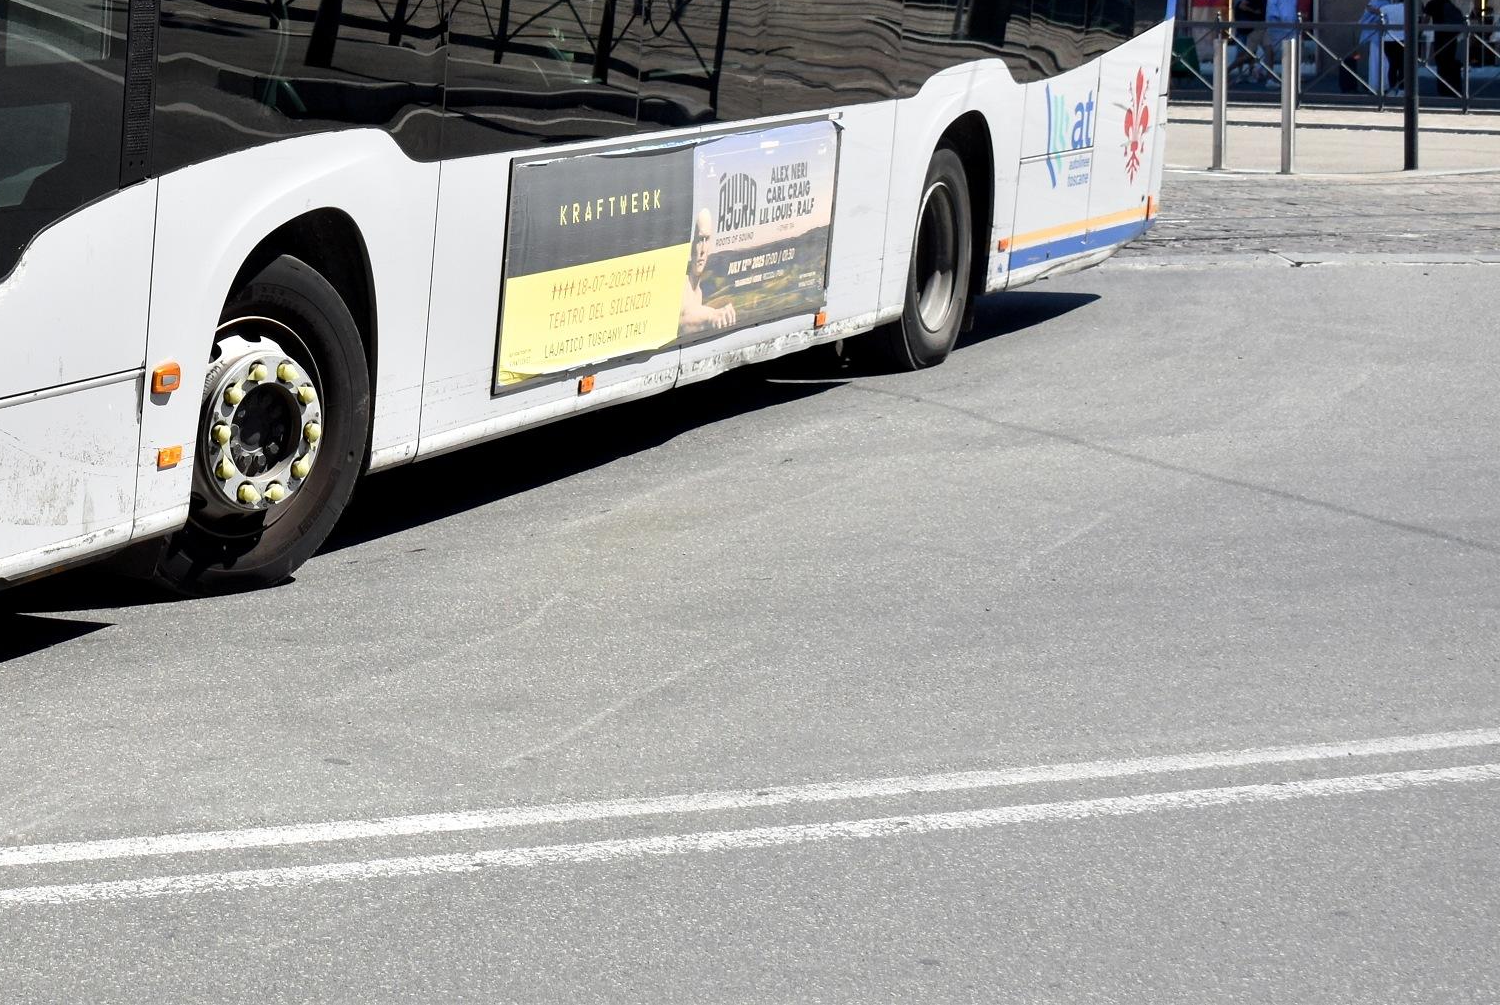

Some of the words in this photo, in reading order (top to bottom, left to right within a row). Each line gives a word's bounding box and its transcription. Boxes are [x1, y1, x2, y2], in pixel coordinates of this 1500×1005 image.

[1071, 90, 1094, 148] at
[771, 165, 790, 184] ALEX
[791, 161, 808, 180] NERI
[766, 185, 786, 204] CARL
[788, 180, 811, 200] CRAIG
[559, 189, 662, 226] KRAFTWERK
[771, 203, 793, 223] LOUIS
[796, 198, 815, 217] RALF
[715, 235, 730, 247] ROOTS
[739, 231, 754, 243] SOUND
[576, 267, 633, 296] 18-07-2025
[549, 304, 585, 329] TEATRO
[588, 301, 605, 321] DEL
[610, 291, 652, 316] SILENZIO
[544, 335, 584, 359] LAJATICO
[588, 327, 623, 348] TUSCANY
[625, 320, 649, 338] ITALY
